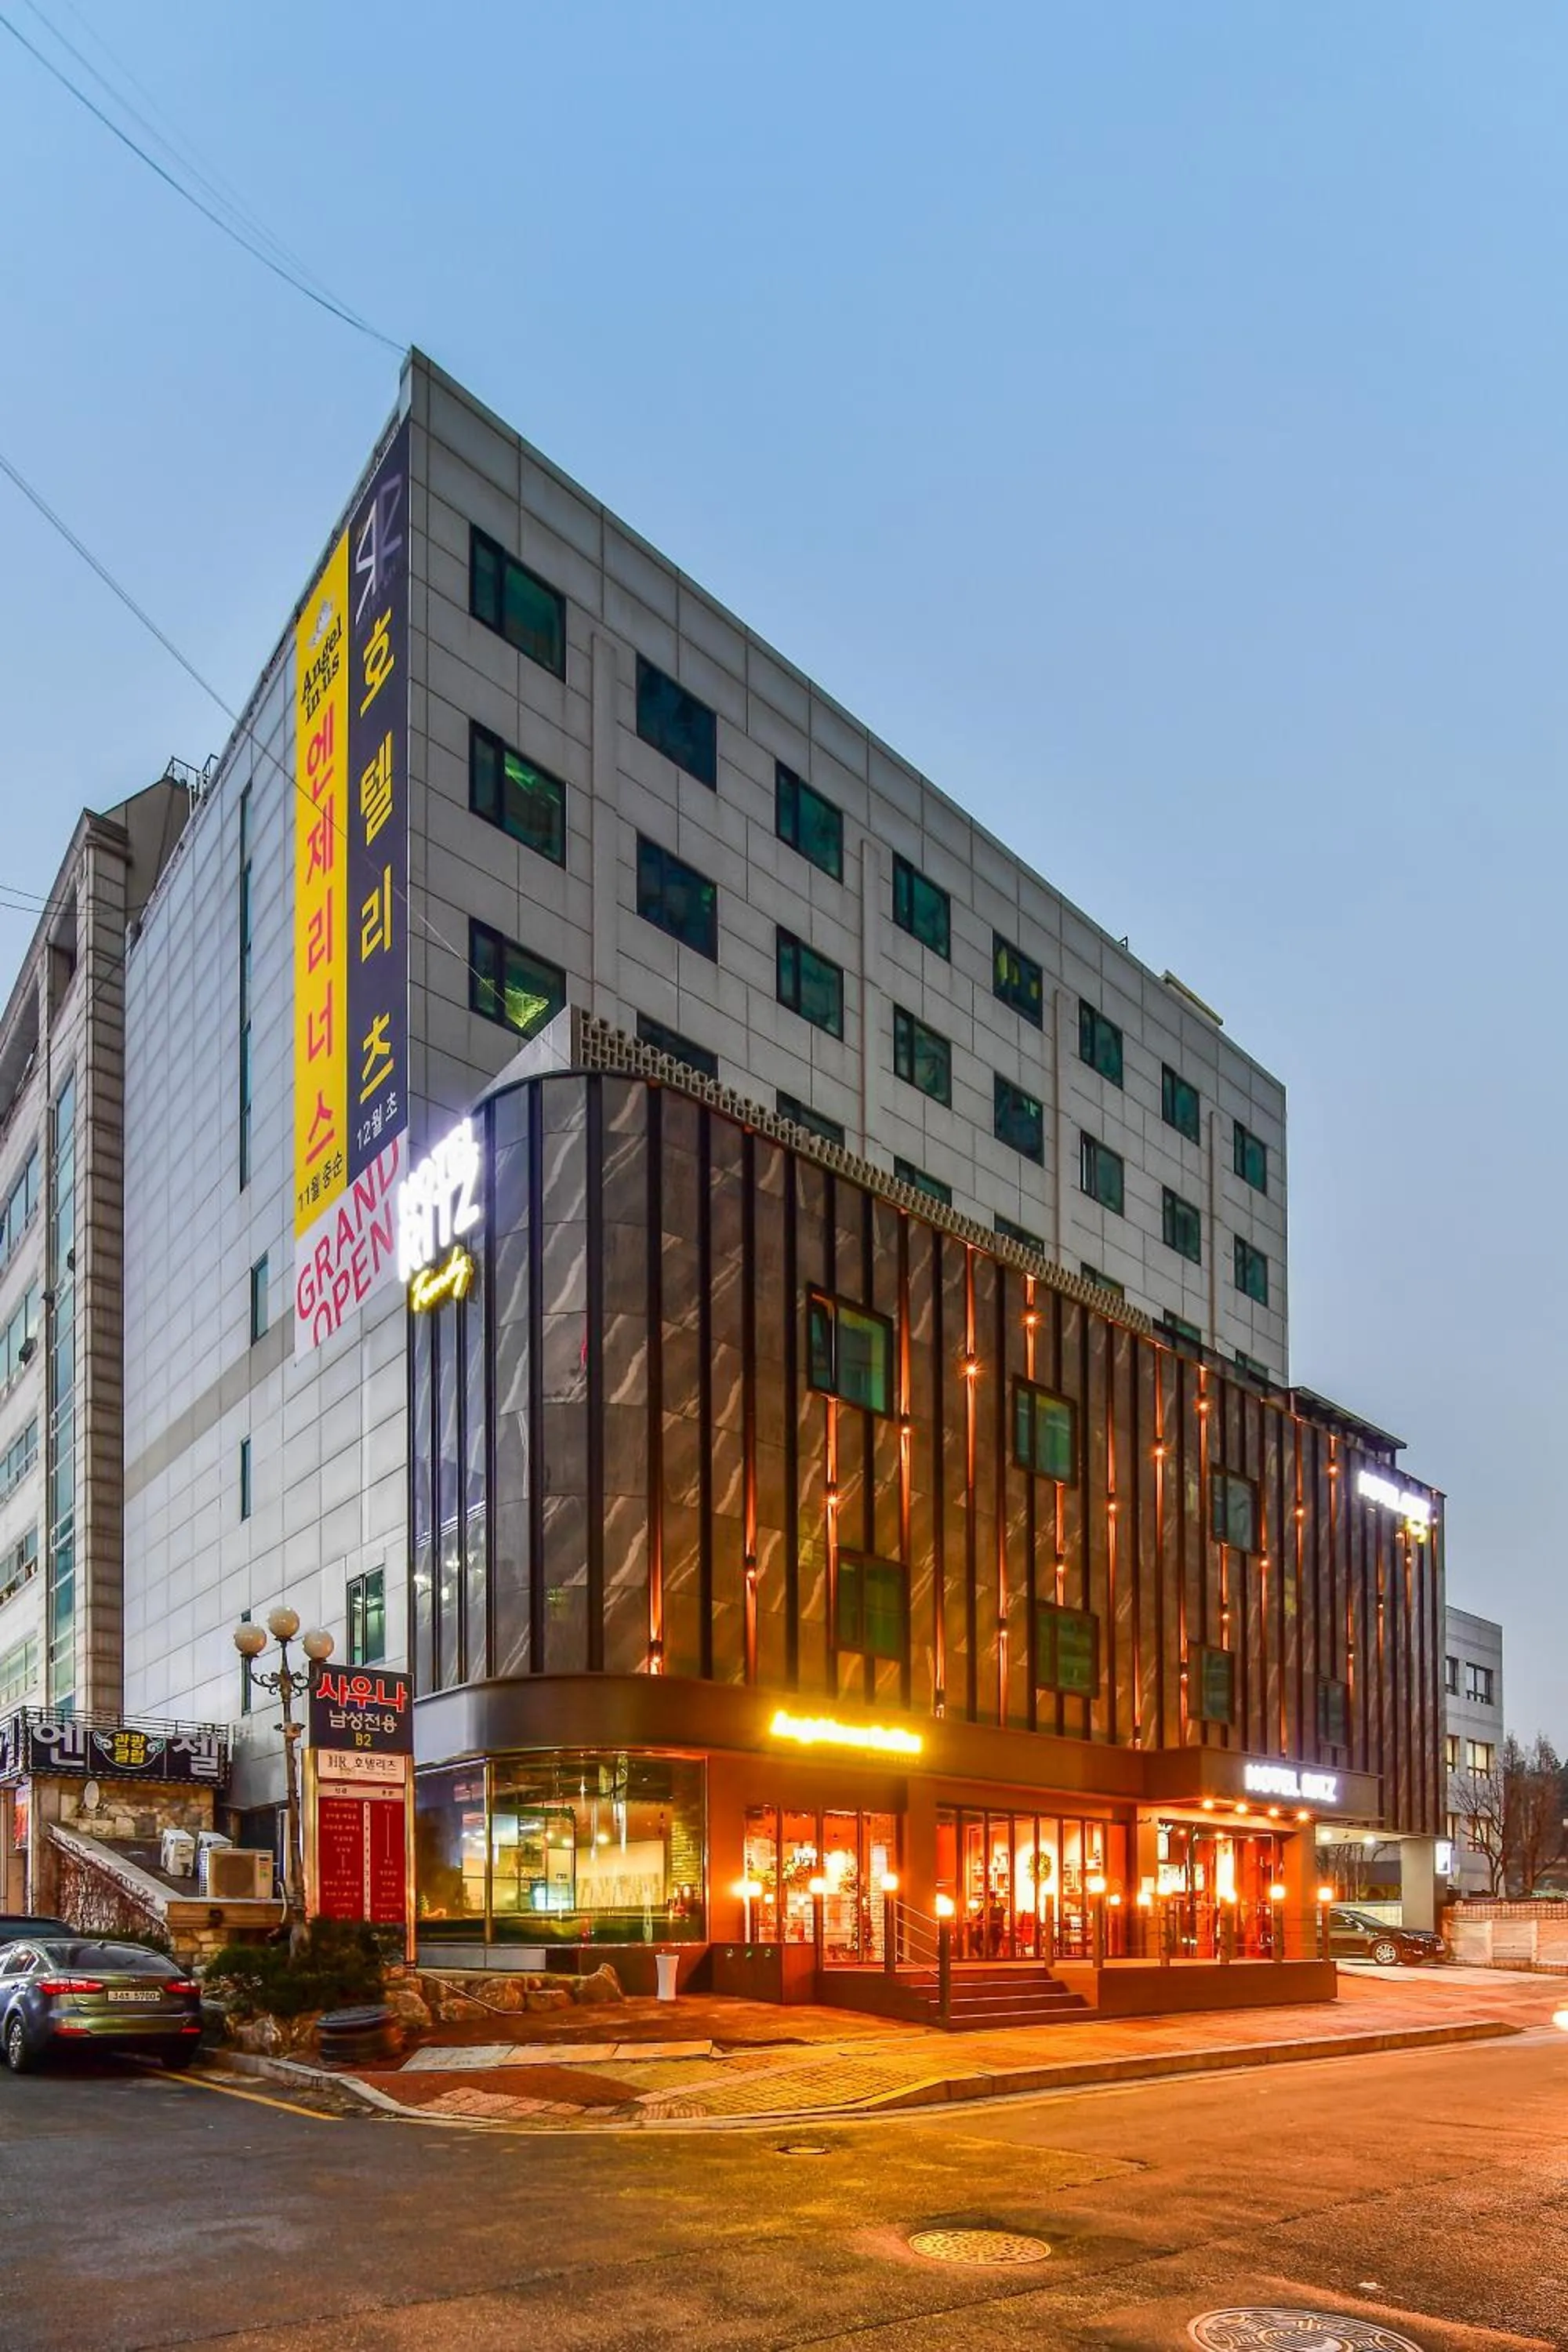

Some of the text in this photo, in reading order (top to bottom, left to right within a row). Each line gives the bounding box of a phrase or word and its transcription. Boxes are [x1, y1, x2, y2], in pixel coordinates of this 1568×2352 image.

[305, 699, 336, 1167] 엔제리너스
[357, 1091, 398, 1151] 12월 초
[298, 1151, 343, 1213] 11월 중순
[297, 1136, 399, 1322] GRAND
[316, 1672, 407, 1713] 사우나
[114, 1733, 146, 1749] 관광
[328, 1709, 397, 1734] 남성전용
[355, 1732, 372, 1747] B2
